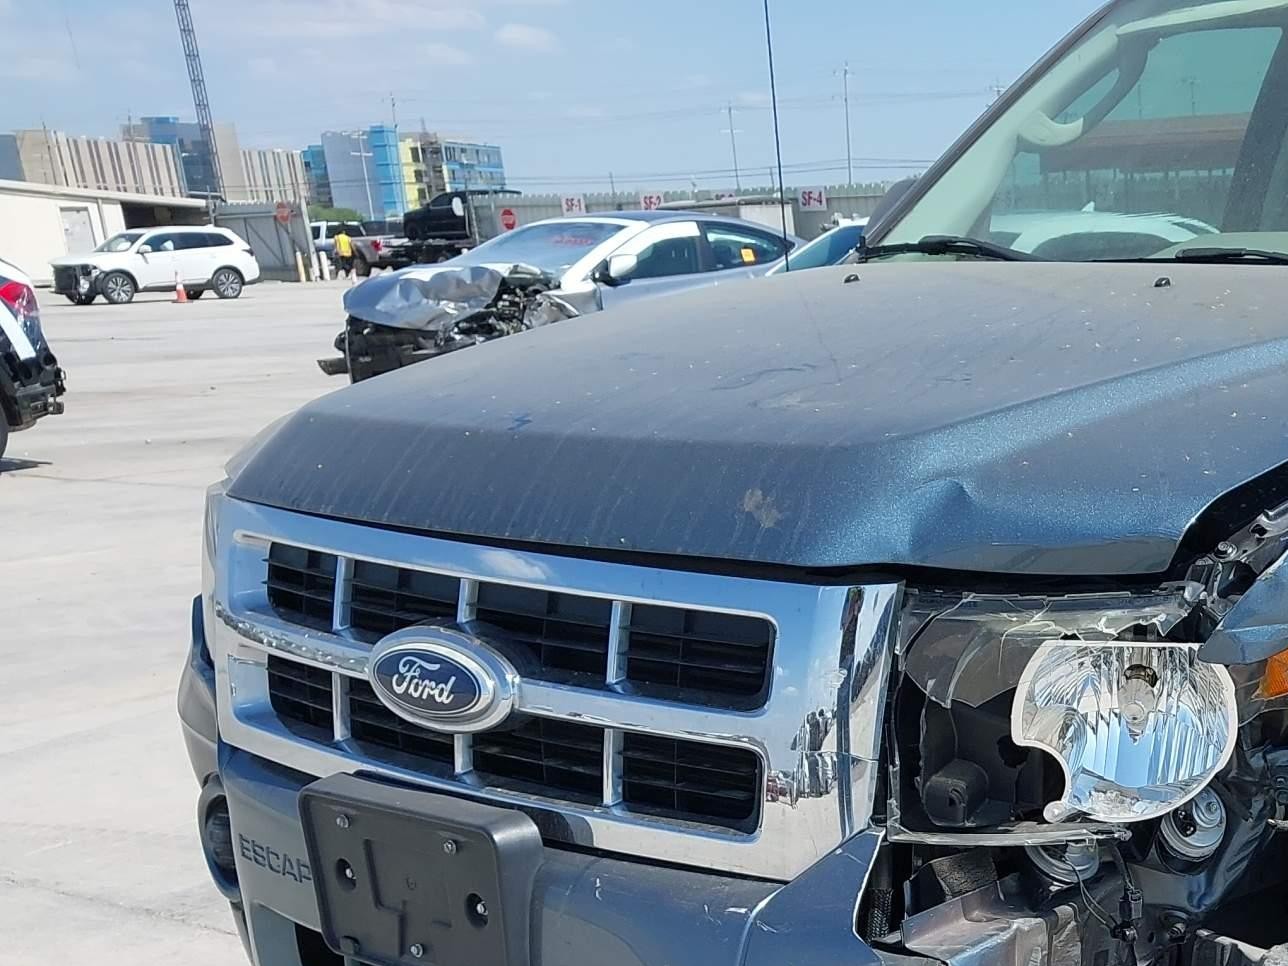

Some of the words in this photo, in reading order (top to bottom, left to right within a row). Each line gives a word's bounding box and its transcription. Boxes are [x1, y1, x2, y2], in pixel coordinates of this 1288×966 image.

[565, 198, 582, 212] SF-1
[801, 191, 823, 206] SF-4
[392, 656, 456, 704] Ford
